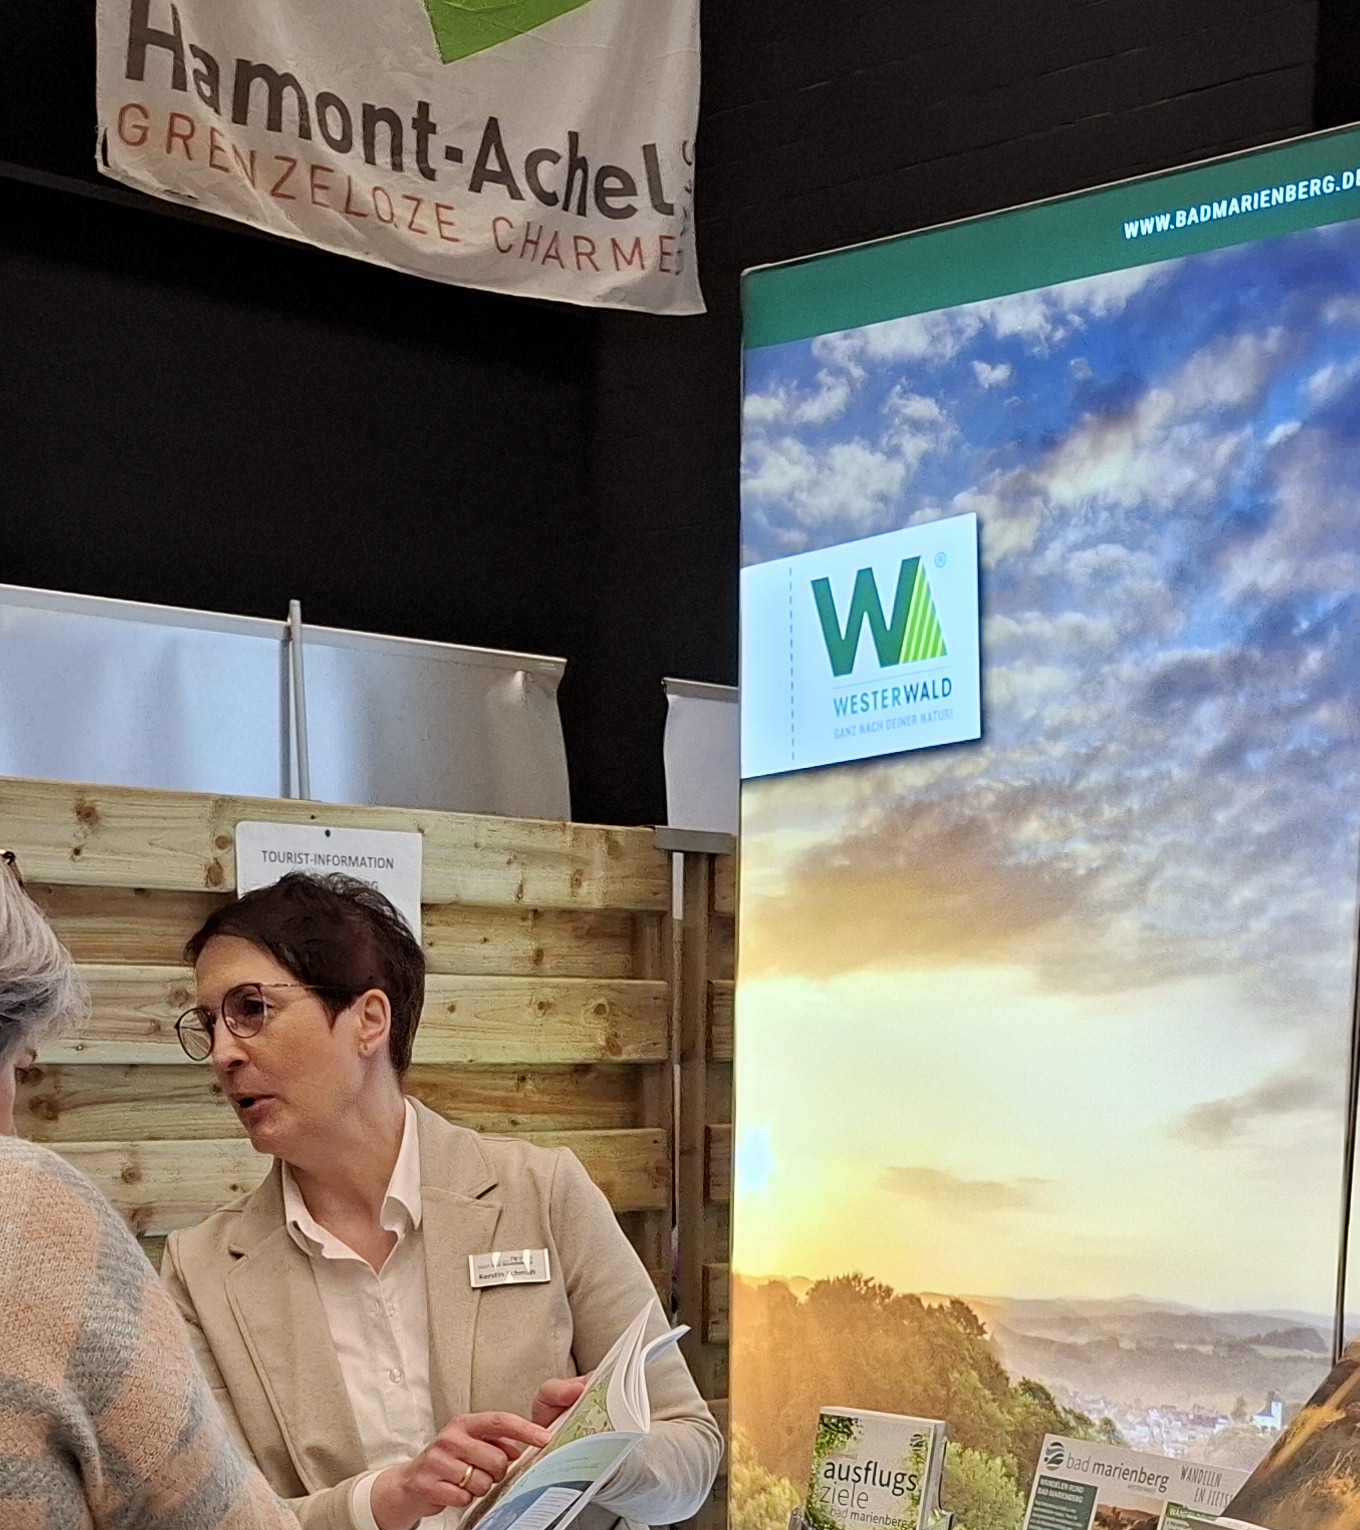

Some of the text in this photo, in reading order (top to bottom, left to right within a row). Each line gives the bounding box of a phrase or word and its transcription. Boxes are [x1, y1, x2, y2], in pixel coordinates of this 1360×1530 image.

[124, 0, 676, 219] Hamont-Achel
[116, 102, 682, 275] GRENZELOZE CHARME
[833, 677, 953, 718] WESTERWALD
[260, 850, 395, 870] TOURIST-INFORMATION
[823, 1460, 919, 1497] ausflugs
[1066, 1452, 1170, 1493] bad marienberg
[1180, 1464, 1223, 1488] WANDELEN
[819, 1482, 870, 1510] ziele
[1193, 1486, 1208, 1503] EN
[849, 1509, 910, 1530] marienberg
